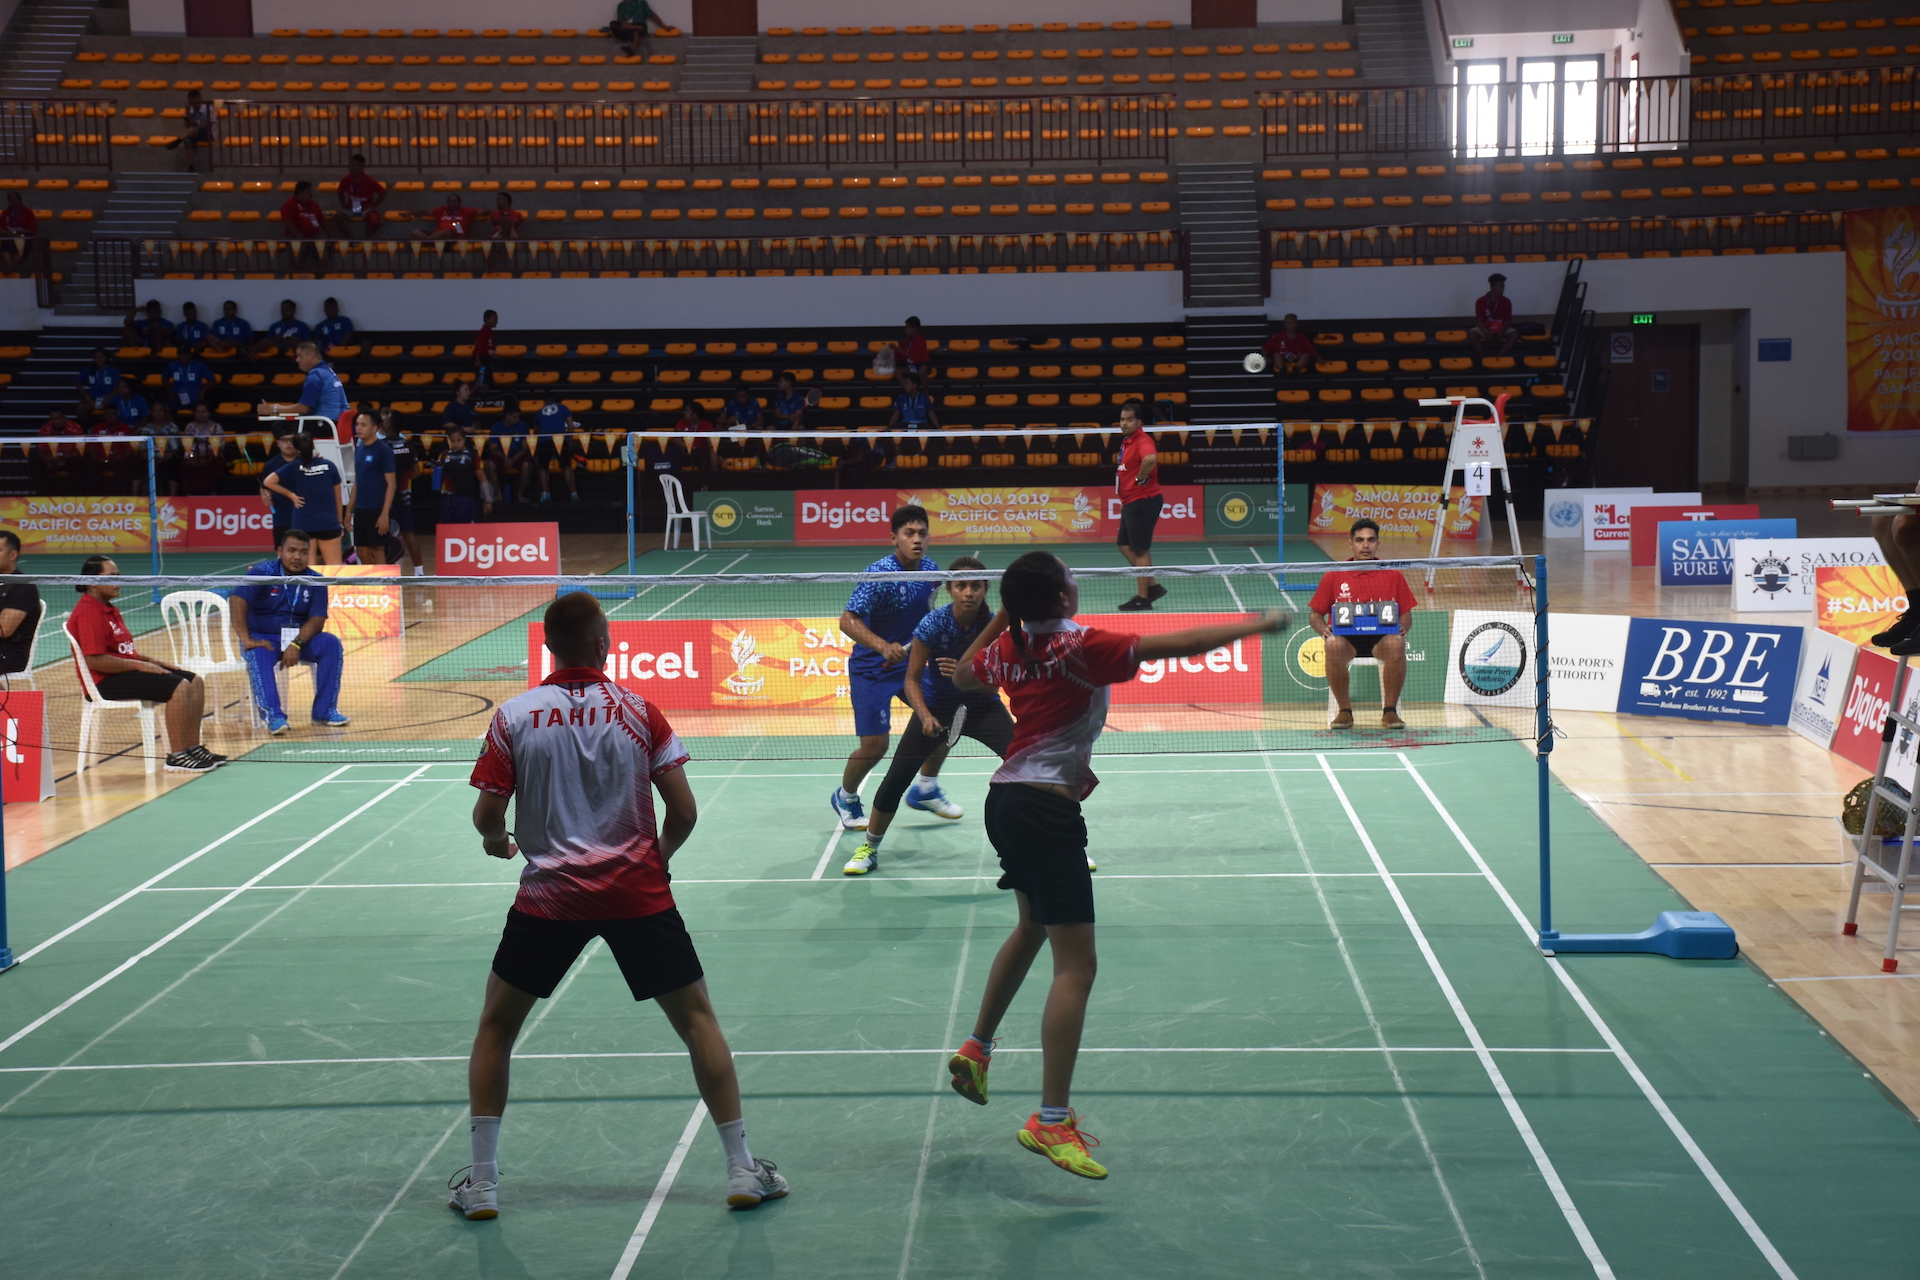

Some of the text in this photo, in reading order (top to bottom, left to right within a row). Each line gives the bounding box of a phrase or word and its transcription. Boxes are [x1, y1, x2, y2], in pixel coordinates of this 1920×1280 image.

[1454, 39, 1472, 48] EXIT
[1555, 34, 1572, 43] EXIT
[1633, 314, 1654, 324] EXIT
[1473, 466, 1484, 480] 4
[947, 493, 1050, 507] SAMOA 2019
[1354, 490, 1439, 506] SAMOA 2019
[28, 502, 136, 515] SAMOA 2019
[801, 501, 890, 529] Digicel
[939, 508, 1058, 522] PACIFIC GAMES
[1107, 497, 1196, 520] Dcel
[1226, 506, 1246, 515] SCB
[1345, 506, 1395, 520] PACIFIC
[714, 511, 734, 521] SCB
[746, 512, 783, 520] Commercial
[19, 518, 143, 531] PACIFIC GAMES
[965, 525, 1032, 534] #SAMOA2019
[45, 533, 116, 544] #SAMOA2019
[1595, 529, 1629, 538] Curren
[444, 537, 549, 569] Digicel
[1801, 551, 1880, 564] SAMOA
[1673, 561, 1718, 576] PURE
[1759, 558, 1784, 569] SSC
[1827, 596, 1910, 614] #SAMO
[1339, 604, 1394, 624] 2 0 1 4
[1578, 657, 1614, 669] PORTS
[1642, 627, 1782, 688] BBE
[1002, 658, 1067, 682] TAITI
[1471, 666, 1512, 676] Samoa Ports
[1475, 674, 1506, 683] Authority
[1685, 688, 1728, 700] est. 1992
[1660, 701, 1741, 715] Betham Brothers Ent, Samoa
[529, 704, 624, 729] TAHITI
